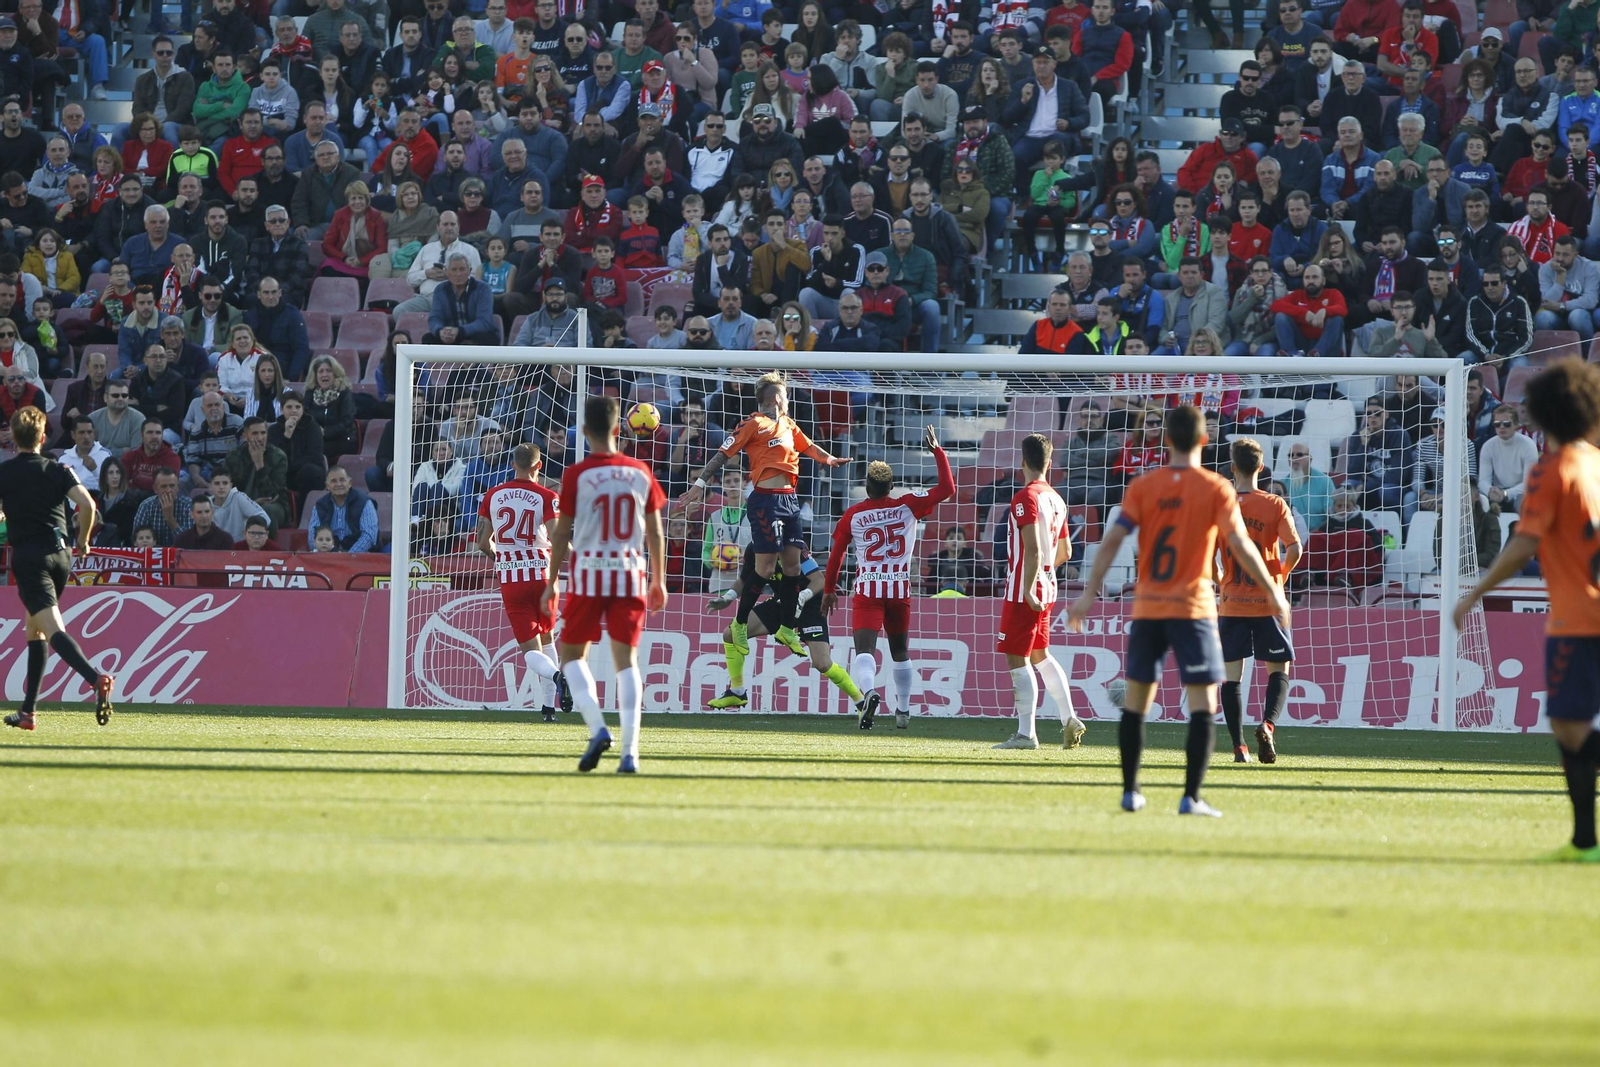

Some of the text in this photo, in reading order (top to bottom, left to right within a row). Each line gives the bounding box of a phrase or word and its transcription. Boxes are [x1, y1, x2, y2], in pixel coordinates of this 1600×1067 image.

[497, 489, 539, 507] SAVELJICH
[496, 506, 537, 547] 24
[592, 492, 636, 545] 10
[863, 522, 906, 562] 25
[1151, 525, 1177, 583] 6
[225, 559, 309, 588] PEÑA
